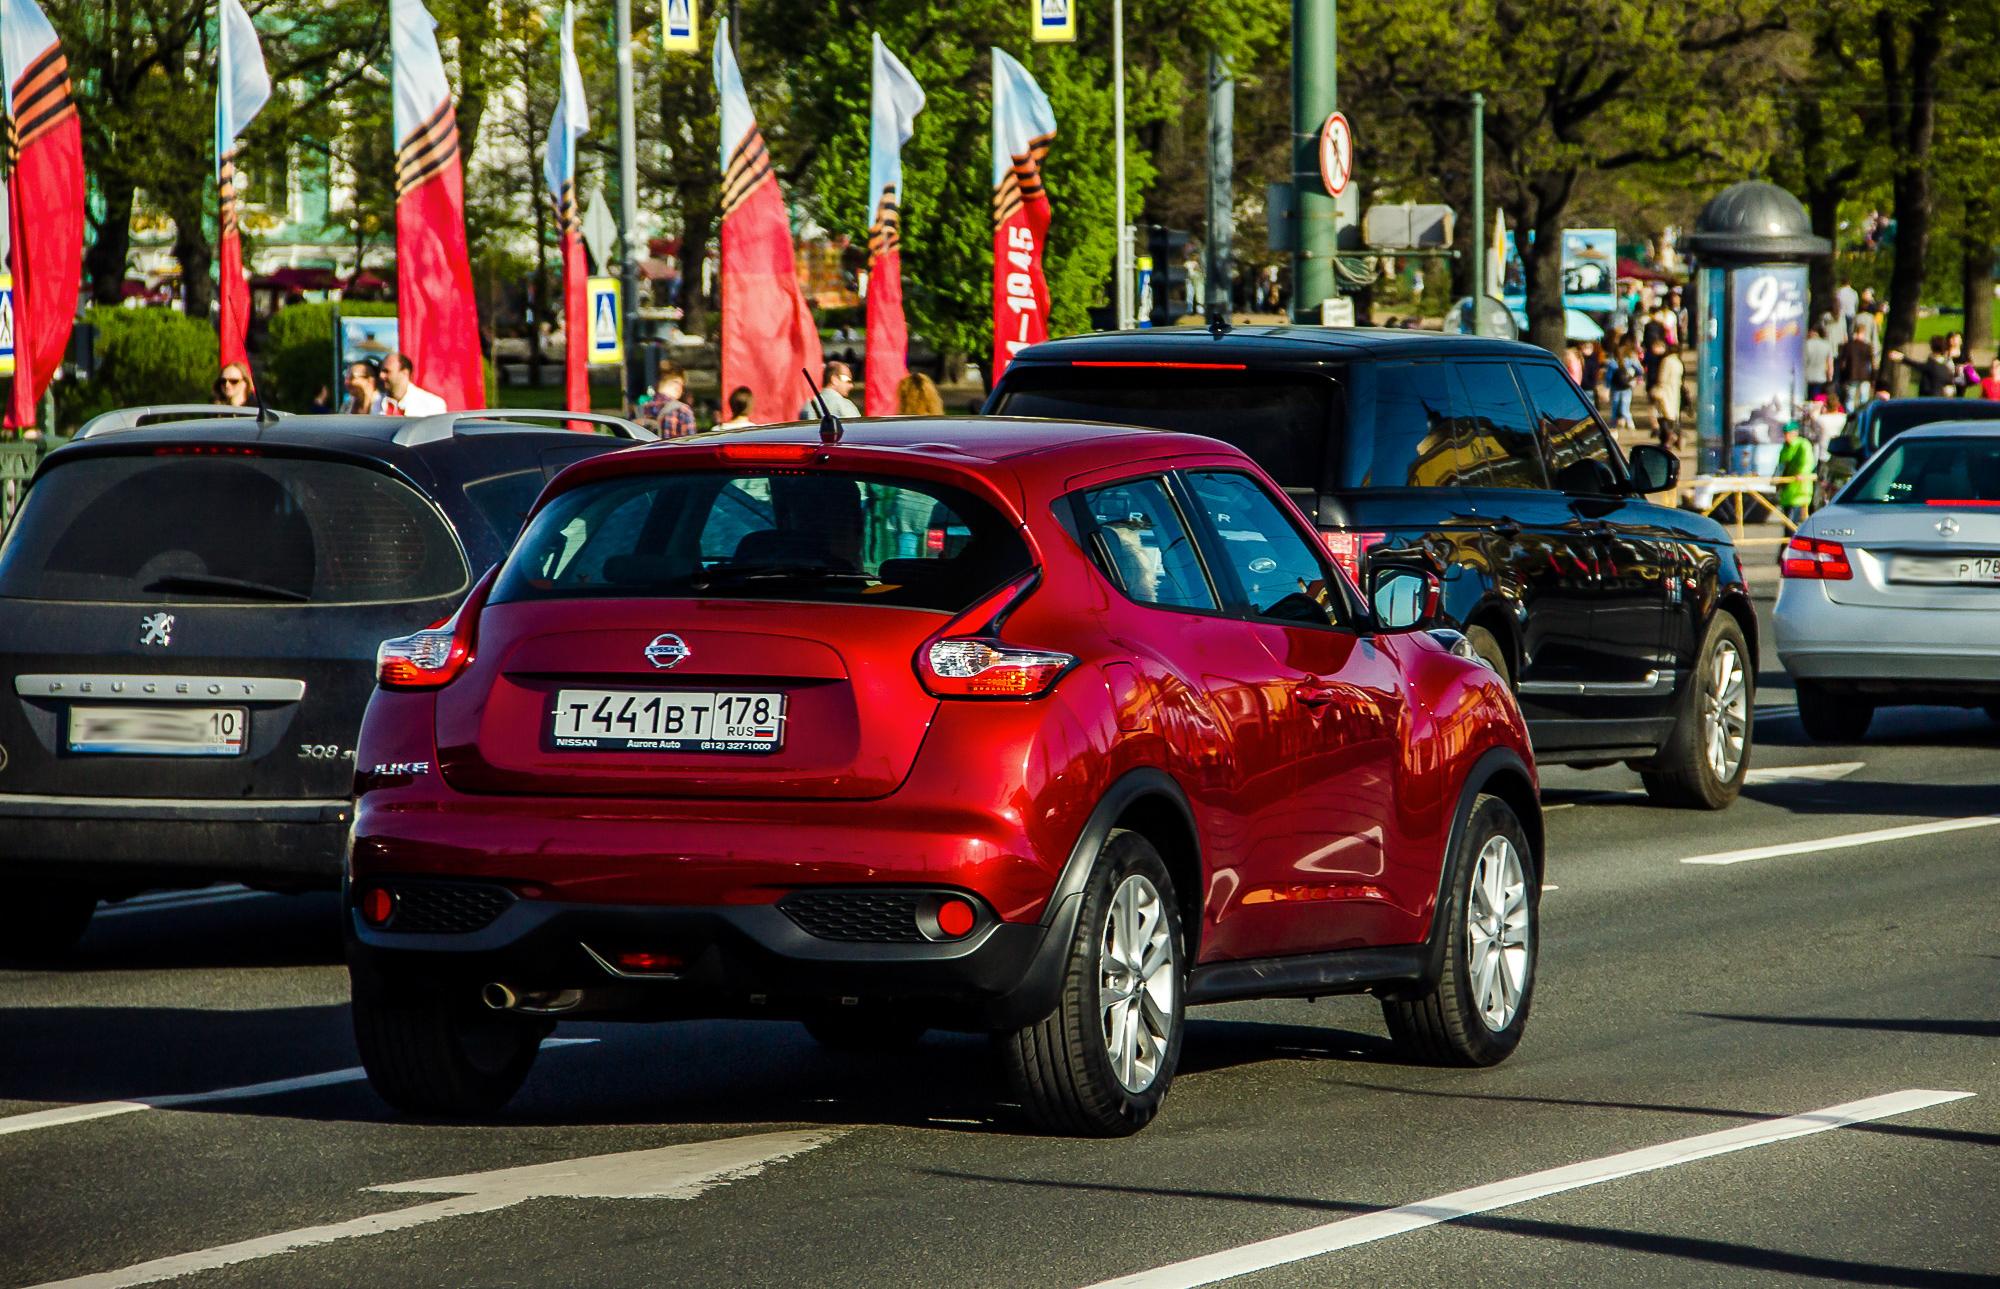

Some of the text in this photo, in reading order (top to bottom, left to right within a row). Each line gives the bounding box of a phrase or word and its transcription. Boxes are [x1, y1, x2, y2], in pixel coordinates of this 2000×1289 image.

[1746, 275, 1778, 325] 9
[49, 682, 255, 695] PEUGEOT
[718, 697, 770, 726] 178
[210, 713, 234, 735] 10
[727, 726, 754, 737] RUS
[297, 744, 339, 759] 308
[556, 738, 771, 750] NISSAN Aurore Auto (812) 327-1000
